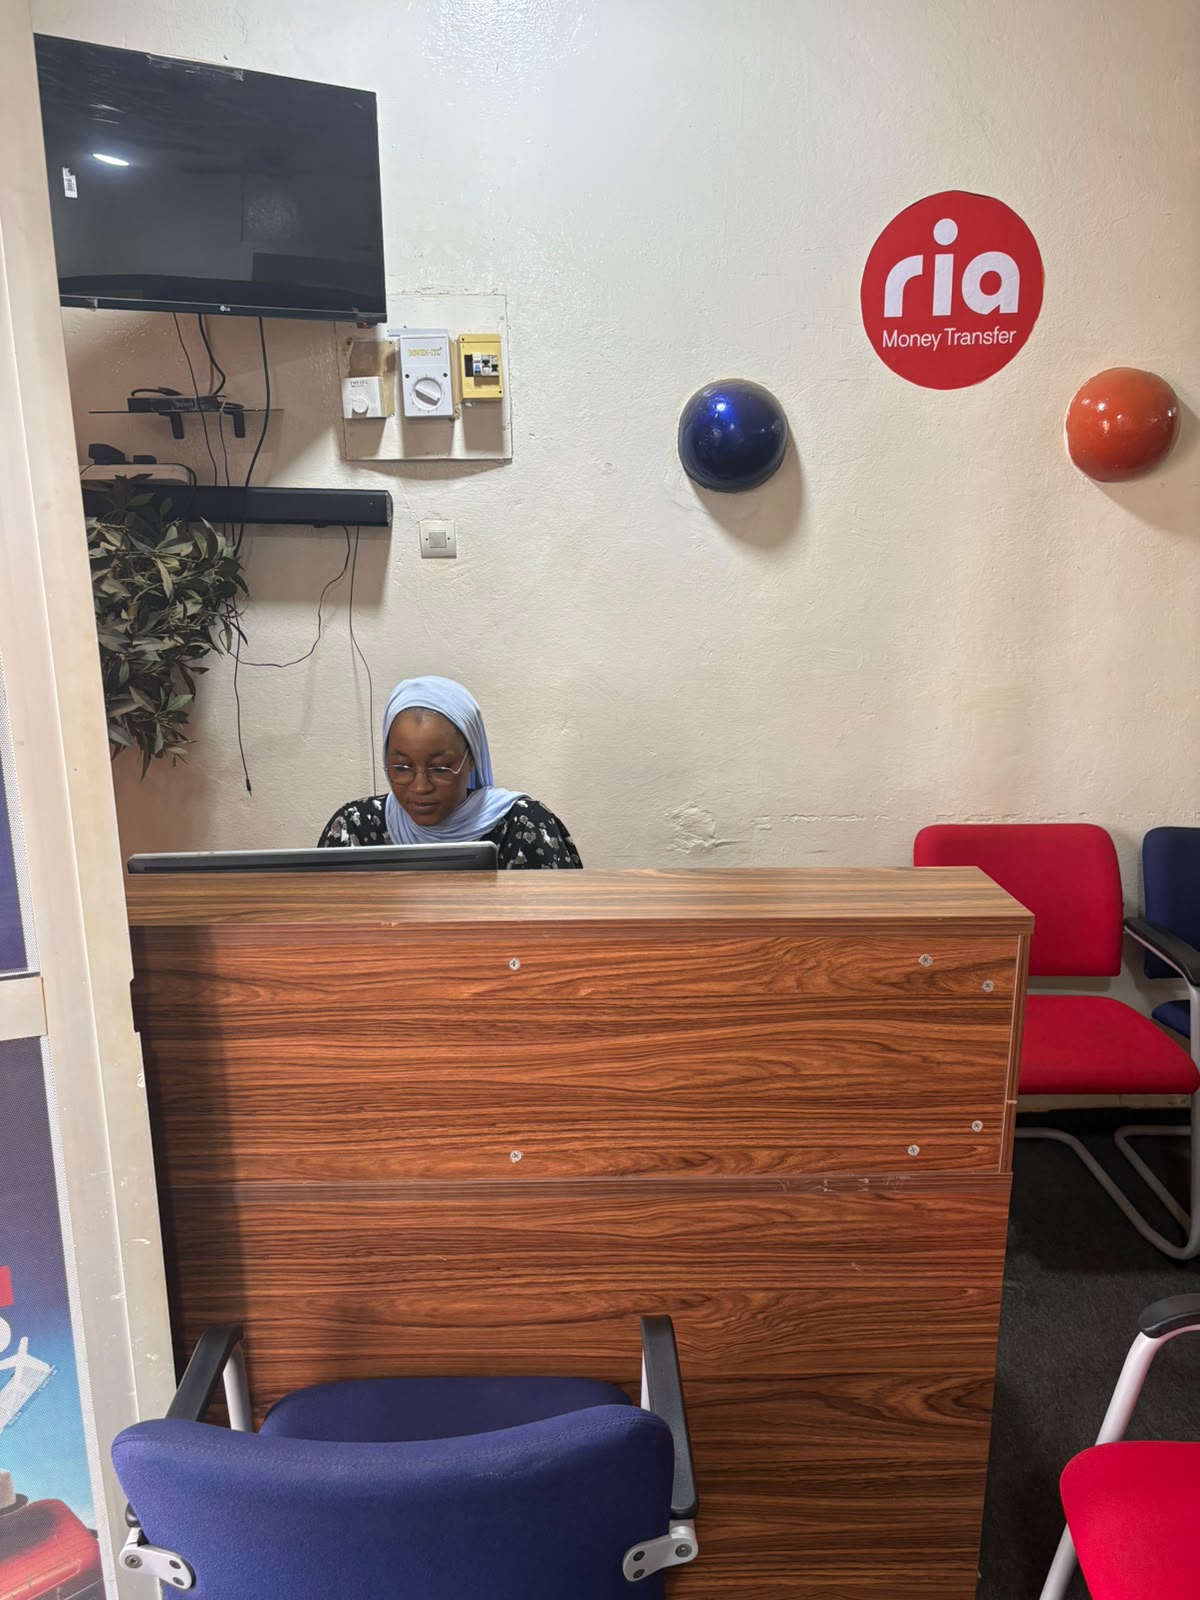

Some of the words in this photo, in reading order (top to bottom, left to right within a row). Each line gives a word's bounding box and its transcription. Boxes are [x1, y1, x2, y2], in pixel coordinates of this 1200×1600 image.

[883, 217, 1021, 318] ria
[882, 329, 942, 352] Money
[944, 325, 1017, 346] Transfer
